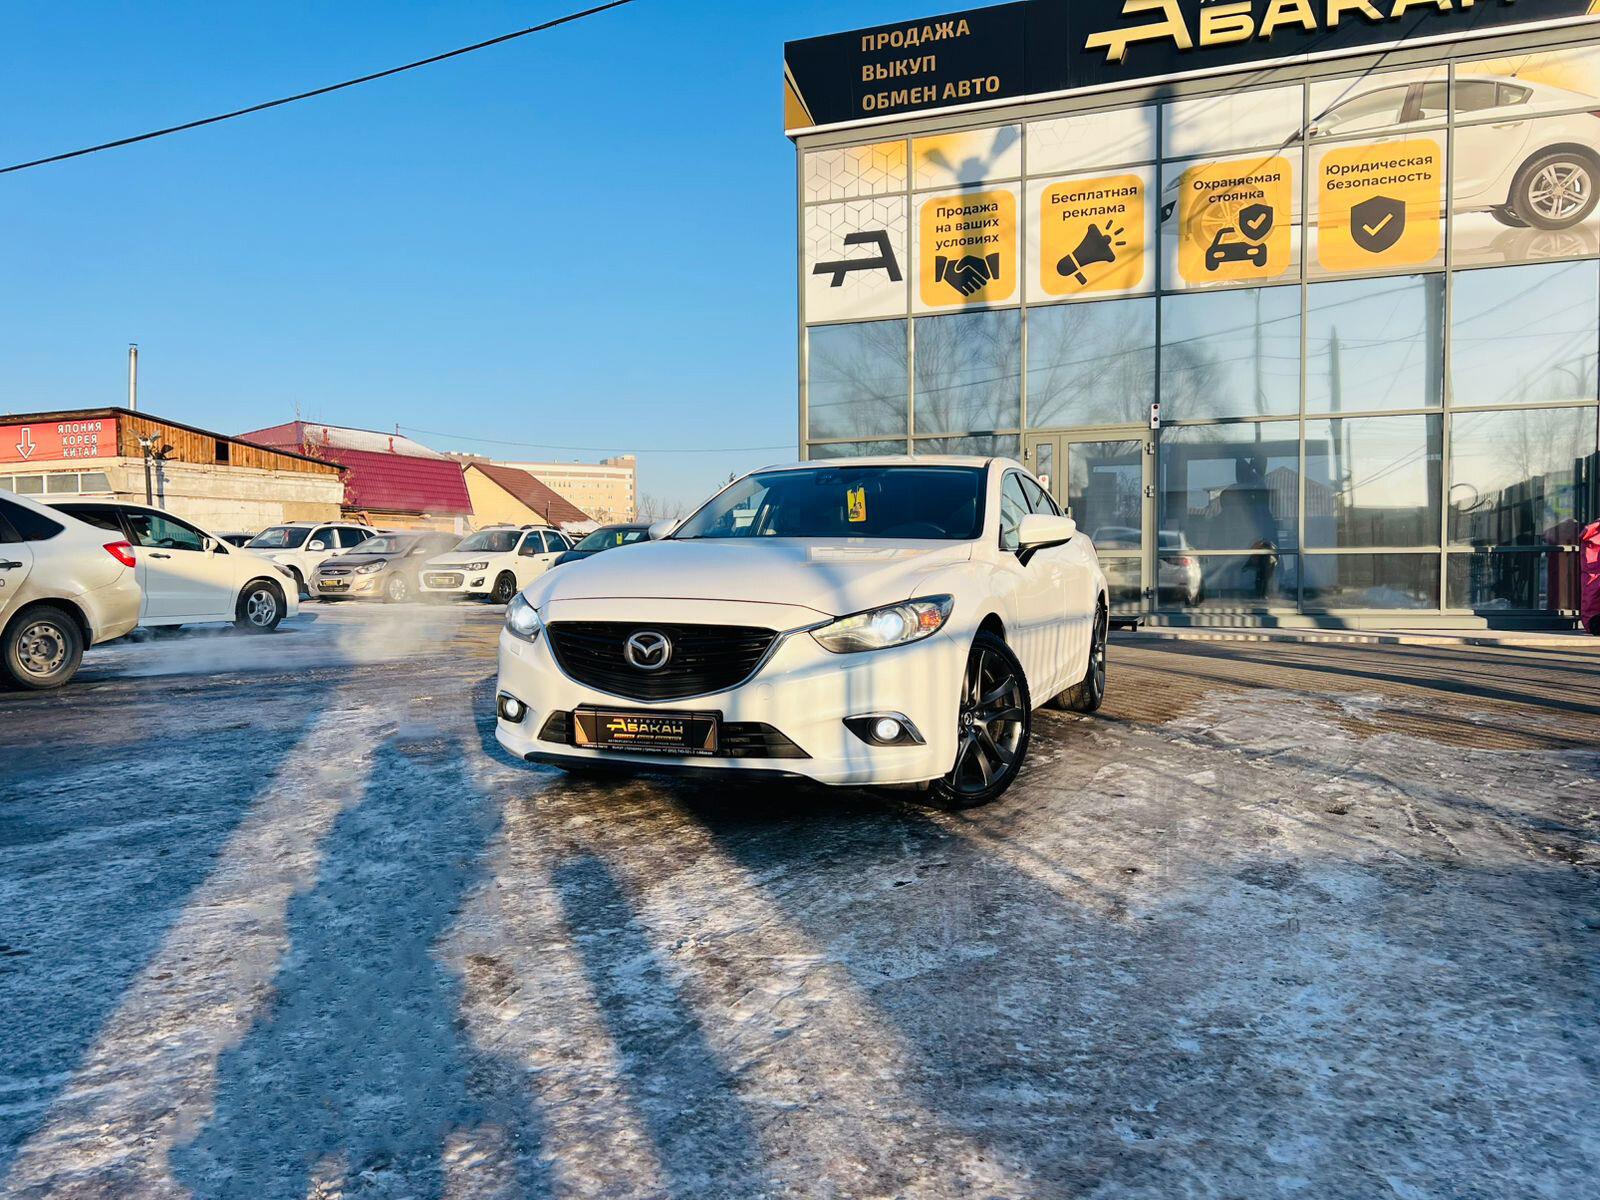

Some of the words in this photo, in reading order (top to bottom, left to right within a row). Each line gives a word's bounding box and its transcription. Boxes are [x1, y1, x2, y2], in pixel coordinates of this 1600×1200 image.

[861, 19, 971, 52] ПРОДАЖА
[1085, 0, 1515, 62] АБАК
[861, 55, 937, 82] ВЫКУП
[862, 86, 937, 111] ОБМЕН
[943, 75, 1000, 100] АВТО
[1325, 154, 1433, 176] Юридическая
[1193, 171, 1282, 191] Охраняемая
[1326, 170, 1433, 191] безопасность
[1051, 185, 1138, 205] Бесплатная
[1208, 189, 1265, 204] стоянка
[936, 202, 999, 219] Продажа
[1062, 203, 1126, 221] реклама
[935, 223, 952, 233] на
[955, 217, 1000, 231] ваших
[935, 233, 1000, 251] условиях
[57, 421, 102, 434] ЯПОНИЯ
[62, 434, 98, 446] КОРЕЯ
[63, 444, 98, 457] КИТАЙ
[606, 717, 684, 734] АБАКАН
